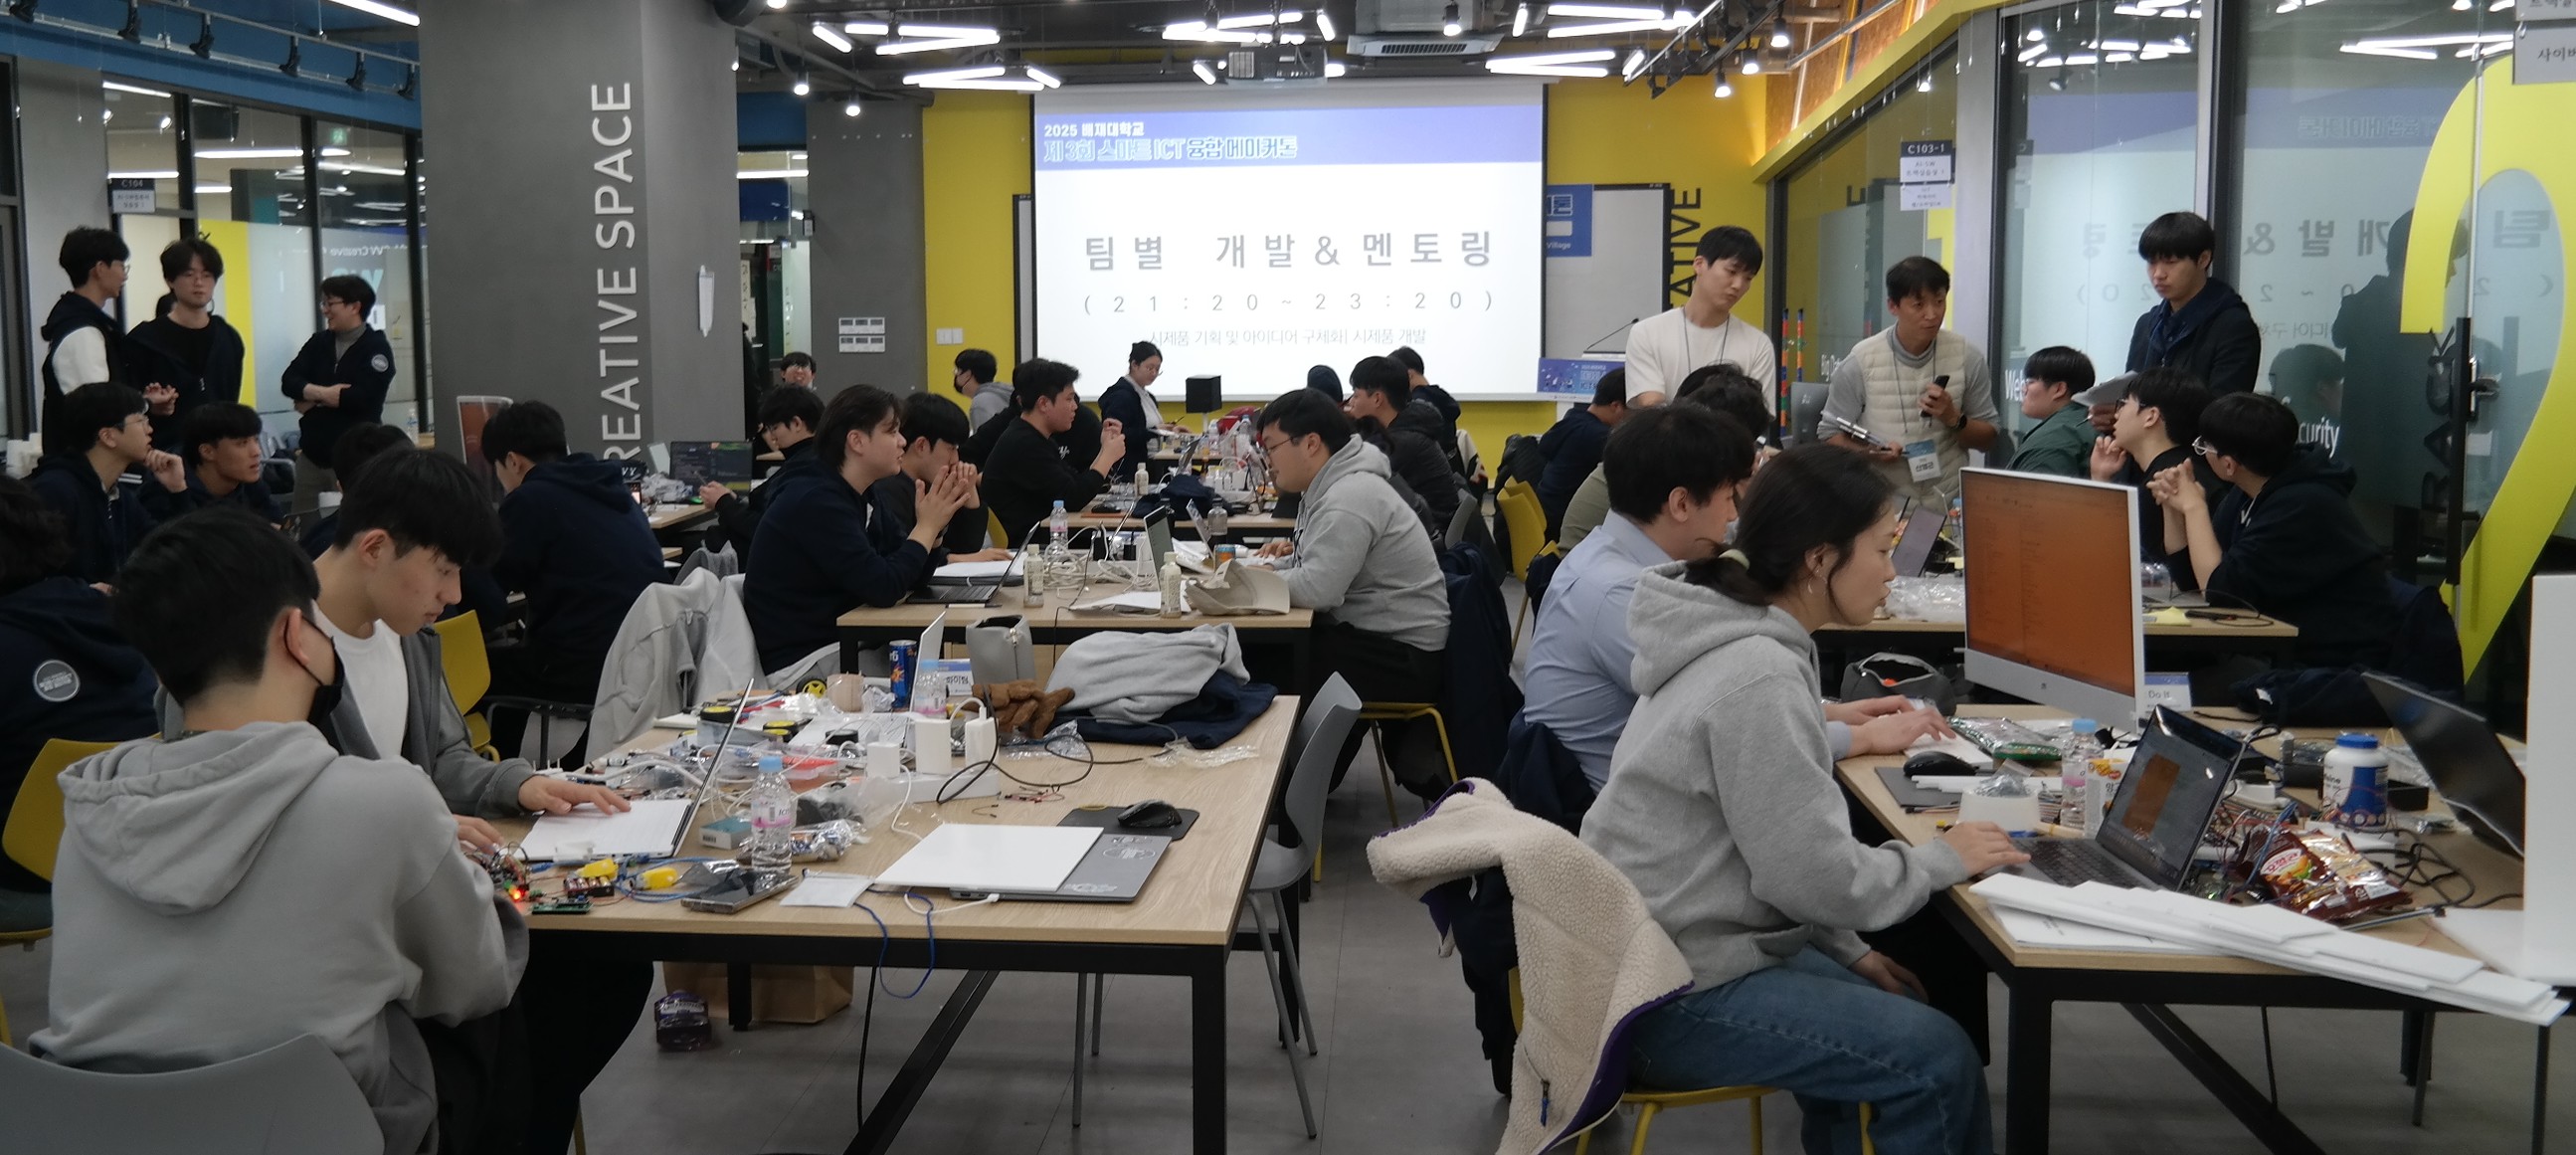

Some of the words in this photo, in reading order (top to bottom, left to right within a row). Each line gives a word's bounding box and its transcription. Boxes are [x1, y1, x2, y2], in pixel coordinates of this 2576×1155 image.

[1044, 124, 1078, 137] 2025
[1081, 121, 1145, 137] 배재대학교
[1153, 137, 1187, 160] ICT
[1187, 136, 1223, 160] 융합
[1908, 143, 1944, 154] C103-1
[591, 82, 636, 249] SPACE
[1149, 330, 1190, 346] 시제품
[1194, 329, 1221, 345] 기획
[1242, 328, 1298, 344] 아이디어
[1353, 328, 1394, 344] 시제품
[1398, 328, 1426, 344] 개발
